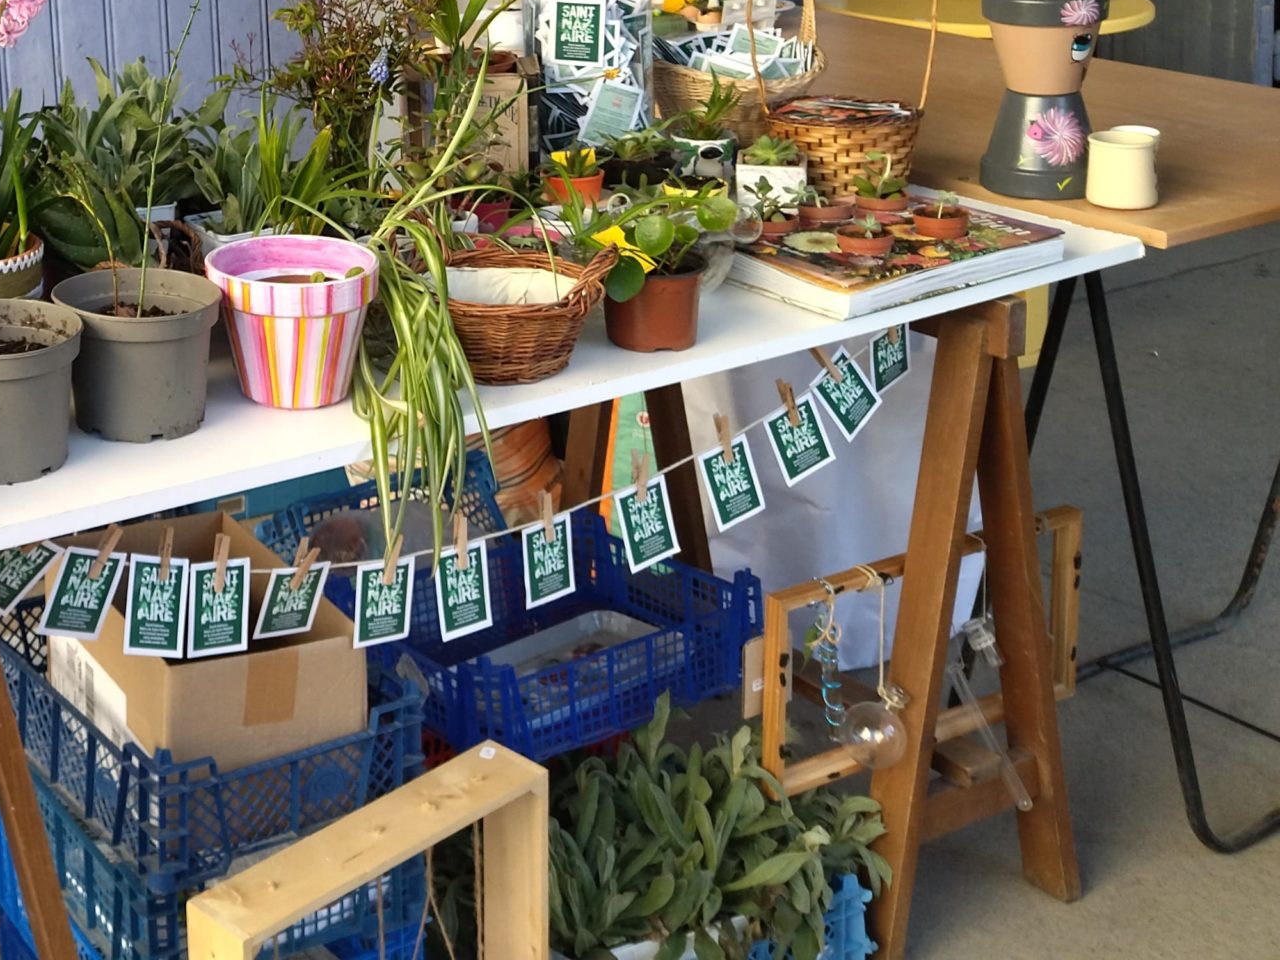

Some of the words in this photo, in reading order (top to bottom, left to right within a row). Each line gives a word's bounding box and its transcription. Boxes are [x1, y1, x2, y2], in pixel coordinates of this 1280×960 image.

[561, 5, 595, 19] SAINT
[560, 29, 594, 43] AIRE
[535, 559, 565, 579] AIRE
[60, 589, 99, 610] AIRE
[448, 587, 480, 607] AIRE
[137, 602, 173, 622] AIRE
[201, 602, 237, 625] AIRE
[366, 600, 401, 617] AIRE
